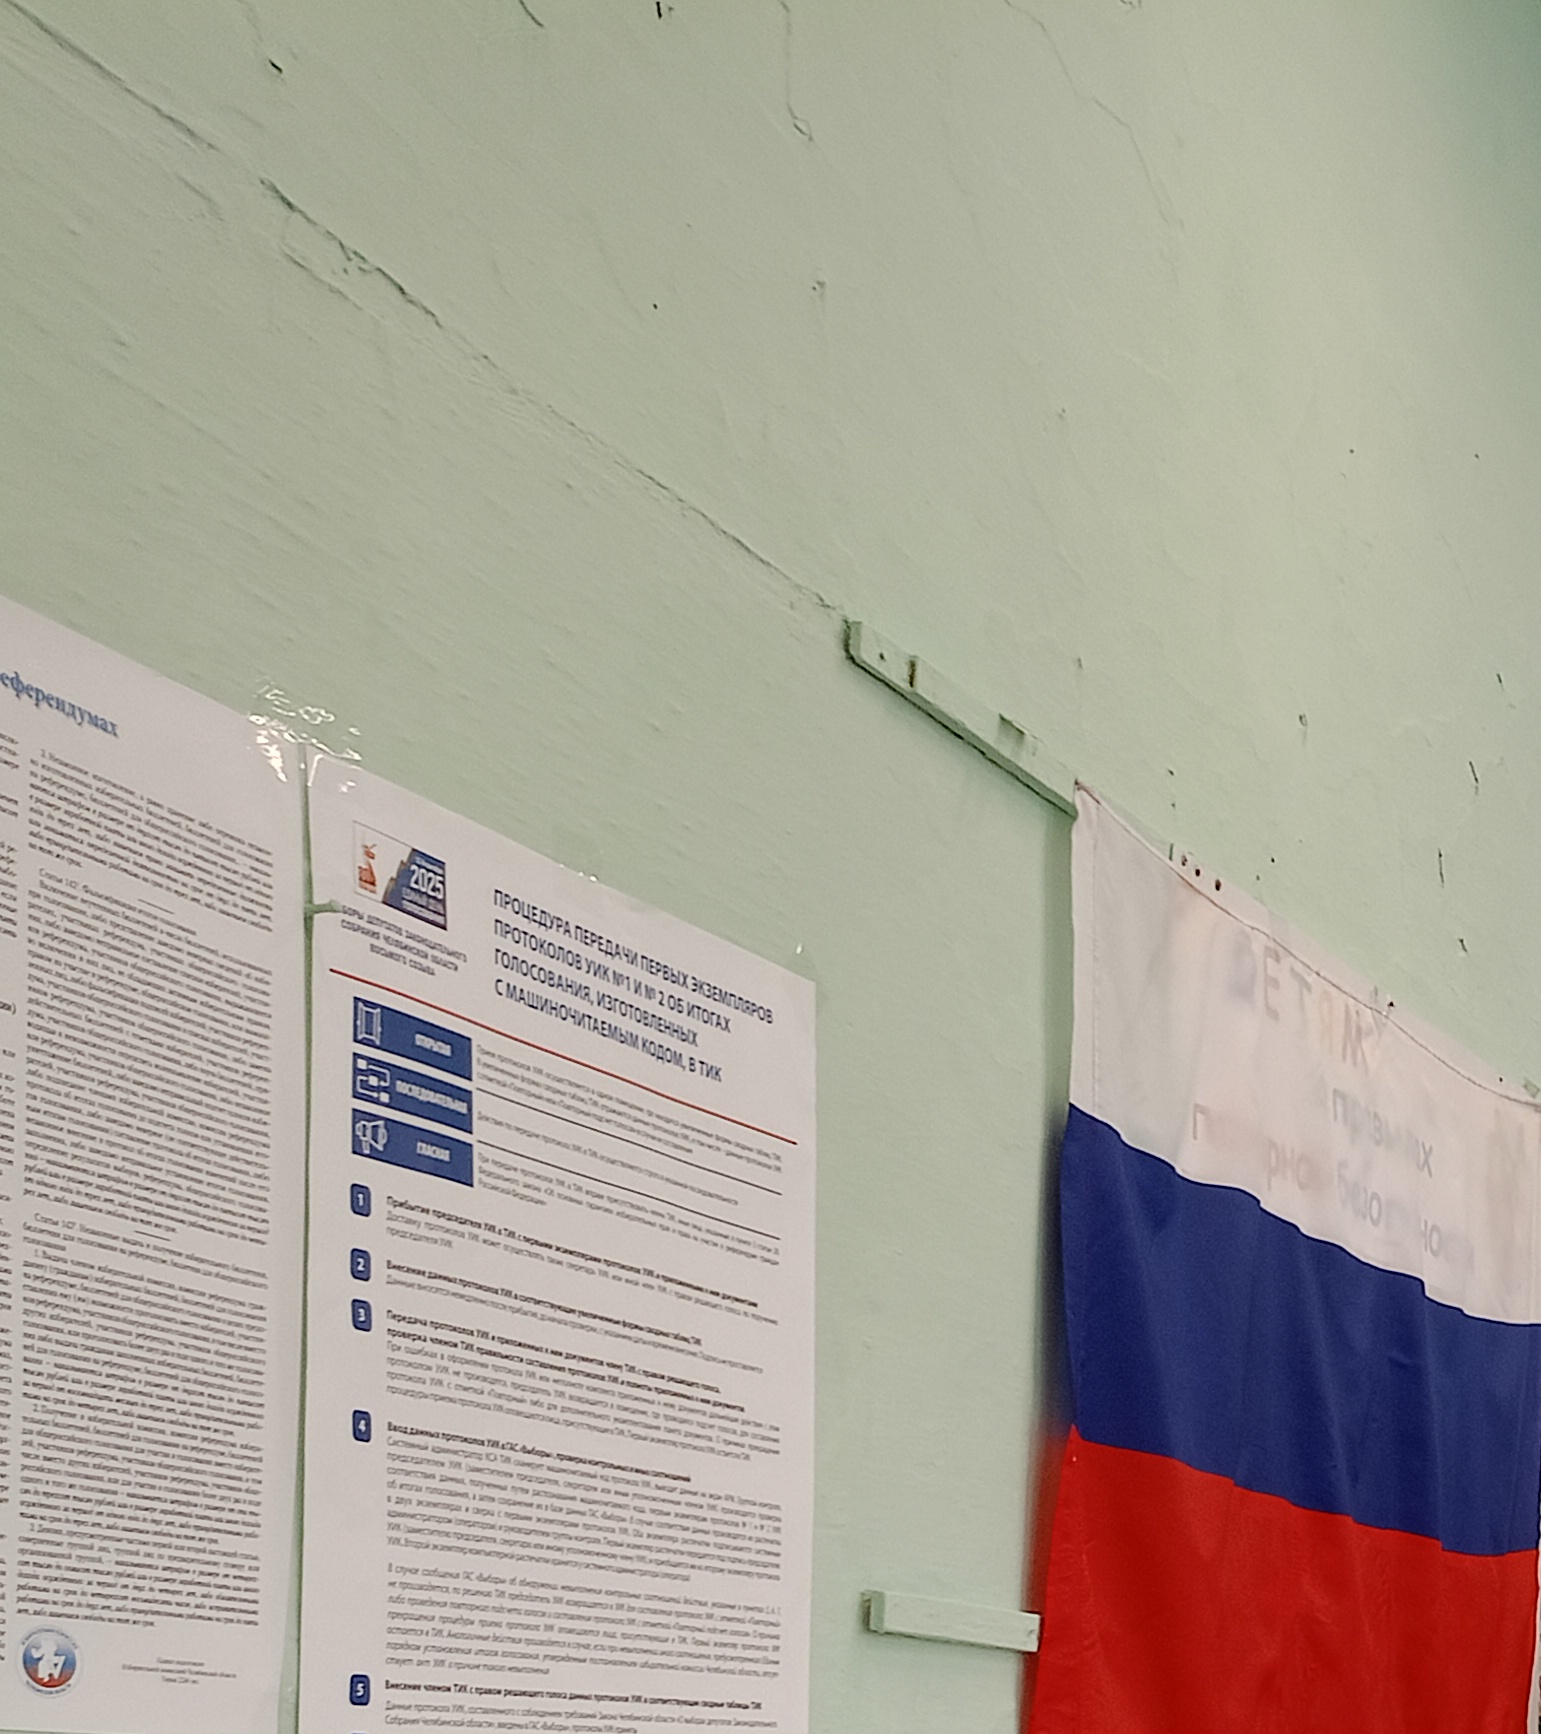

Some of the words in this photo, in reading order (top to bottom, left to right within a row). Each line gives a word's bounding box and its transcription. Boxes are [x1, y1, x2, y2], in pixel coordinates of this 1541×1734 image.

[409, 861, 444, 901] 2025
[493, 887, 572, 941] ПРОЦЕДУРА
[574, 923, 638, 970] ПЕРЕДАЧИ
[640, 954, 689, 990] ПЕРВЫХ
[690, 975, 773, 1025] ЭКЗЕМПЛЯРОВ
[494, 918, 582, 972] ПРОТОКОЛОВ
[584, 956, 610, 984] УИК
[633, 977, 642, 997] И
[658, 989, 665, 1007] 2
[667, 993, 684, 1015] ОБ
[686, 1000, 731, 1034] ИТОГАХ
[494, 947, 594, 1007] ГОЛОСОВАНИЯ,
[596, 989, 698, 1047] ИЗГОТОВЛЕННЫХ
[495, 977, 504, 998] С
[505, 981, 639, 1049] МАШИНОЧИТАЕМЫМ
[641, 1037, 686, 1072] КОДОМ,
[688, 1055, 696, 1073] В
[698, 1058, 721, 1083] ТИК
[357, 1192, 363, 1207] 1
[356, 1256, 365, 1272] 2
[357, 1307, 365, 1322] 3
[357, 1418, 367, 1433] 4
[355, 1682, 364, 1696] 5
